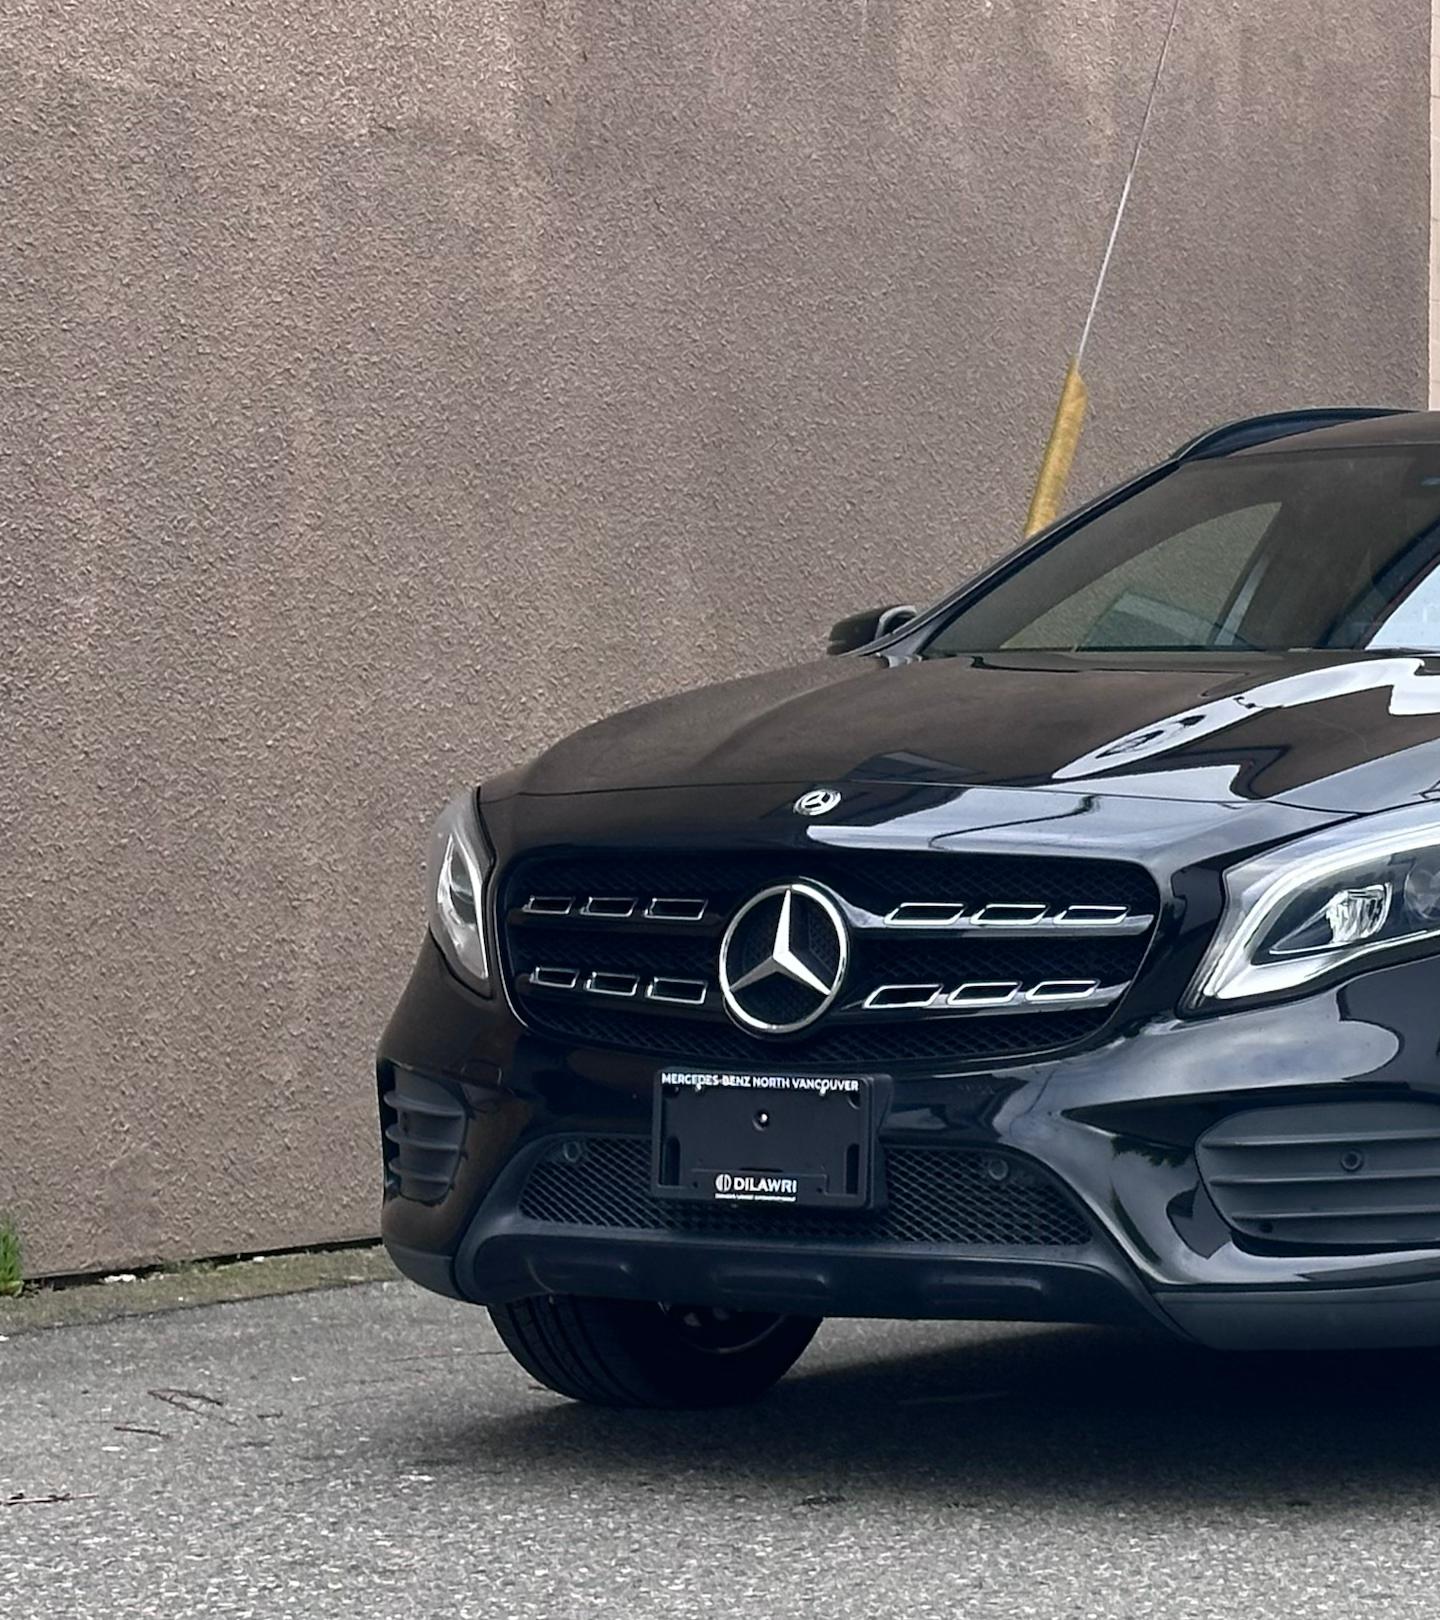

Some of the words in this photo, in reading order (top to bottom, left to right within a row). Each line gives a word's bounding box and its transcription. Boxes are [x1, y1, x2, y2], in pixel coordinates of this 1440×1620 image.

[661, 1072, 752, 1088] MERCEDES-BENZ
[752, 1076, 790, 1089] NORTH
[791, 1077, 859, 1092] VANCOUVER
[733, 1176, 797, 1193] DILAWRI
